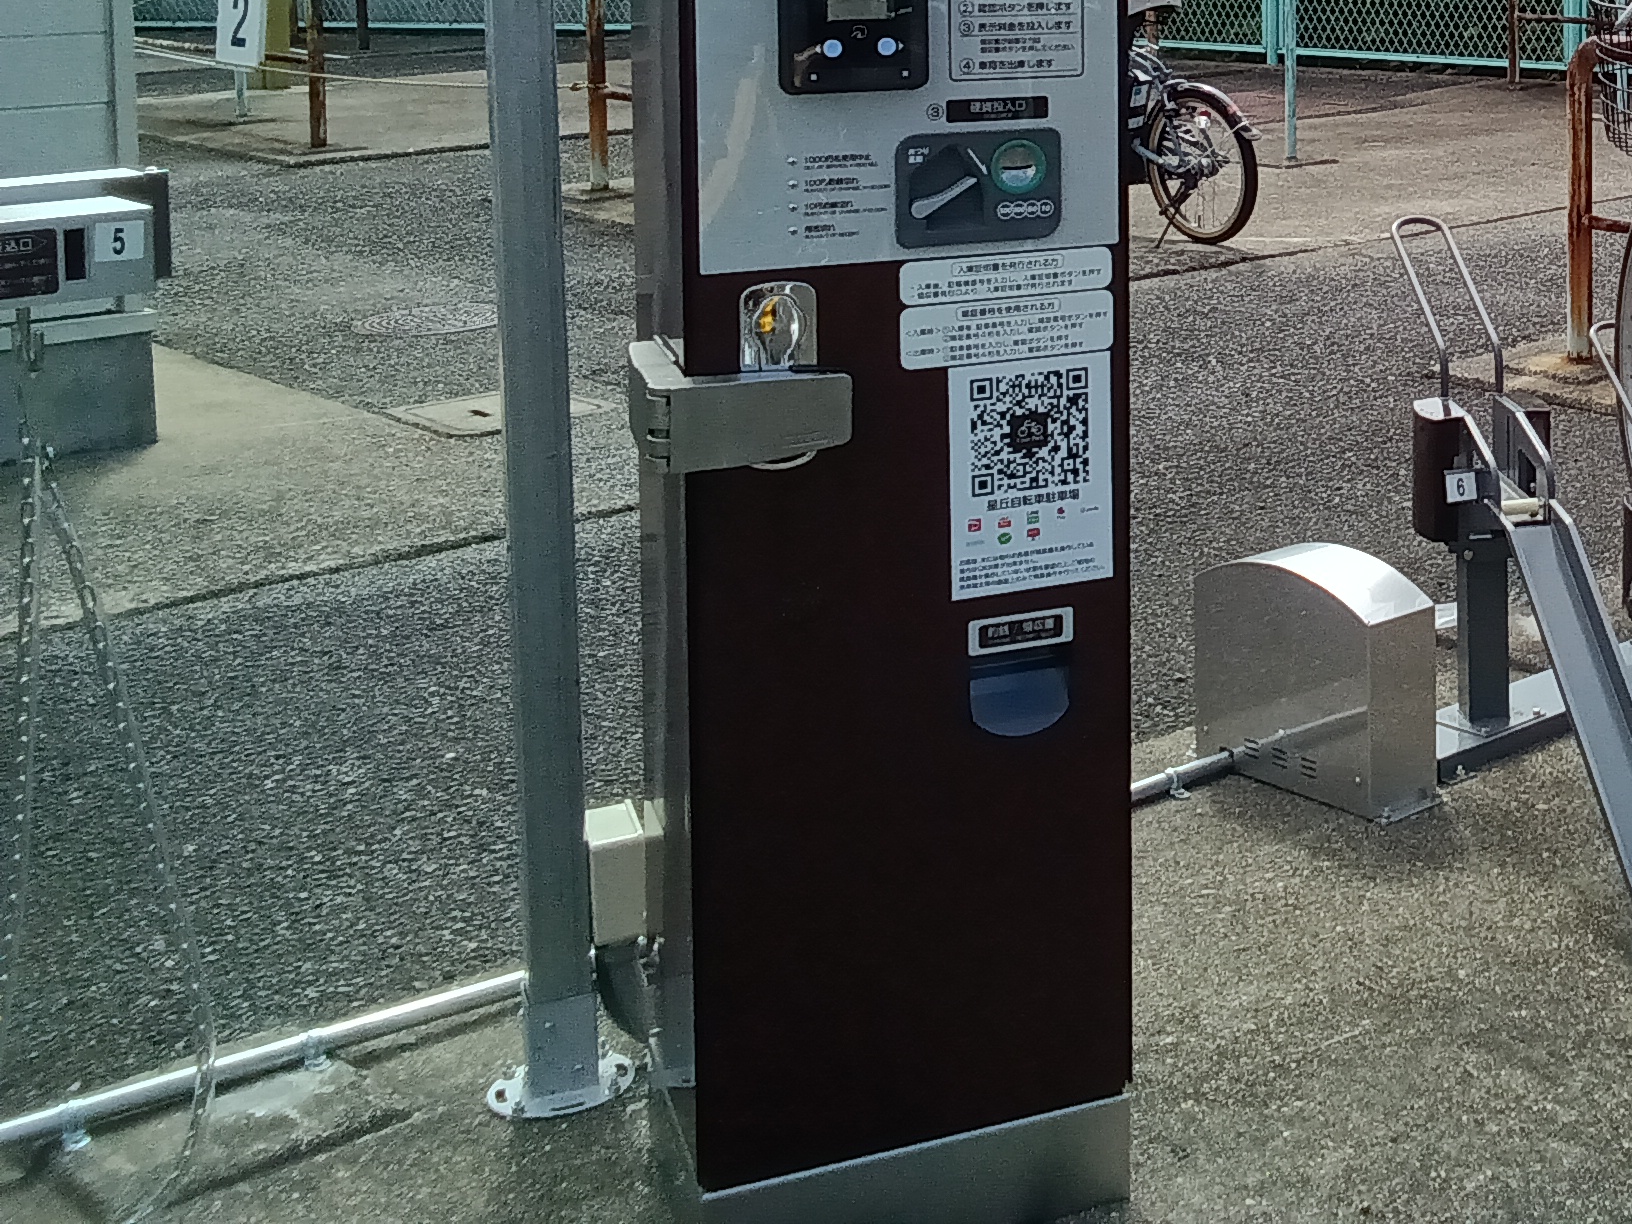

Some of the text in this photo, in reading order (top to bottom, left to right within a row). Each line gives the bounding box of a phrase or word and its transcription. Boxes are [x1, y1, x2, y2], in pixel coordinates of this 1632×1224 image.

[0, 237, 33, 253] 込口
[111, 227, 126, 256] 5
[1456, 477, 1466, 497] 6
[986, 488, 1080, 512] 星丘自転車駐車場
